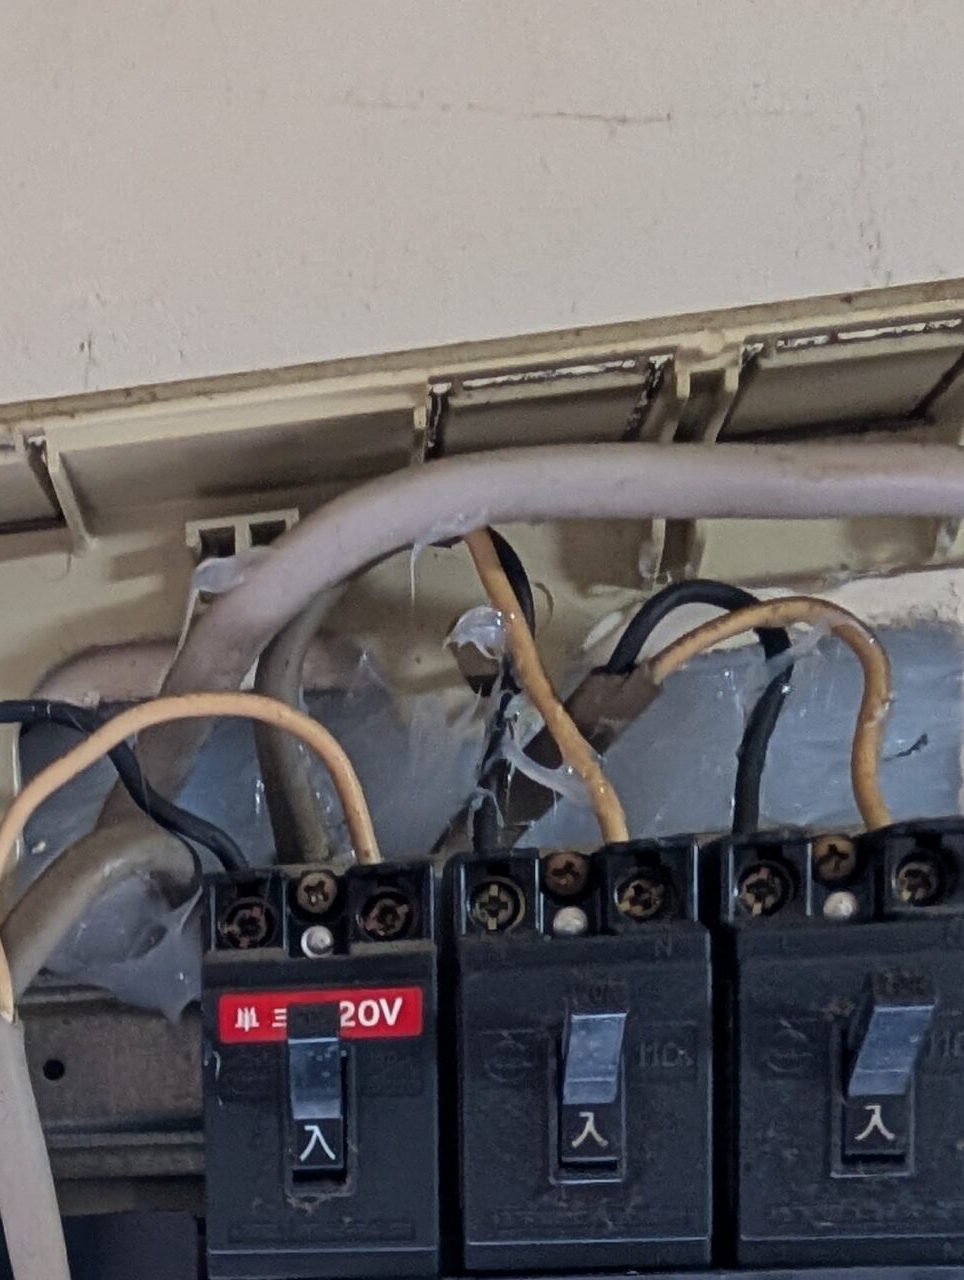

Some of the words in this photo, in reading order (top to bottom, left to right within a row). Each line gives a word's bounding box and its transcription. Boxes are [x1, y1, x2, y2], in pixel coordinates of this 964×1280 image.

[571, 1111, 609, 1149] 入
[854, 1104, 896, 1142] 入
[299, 1125, 336, 1162] 入
